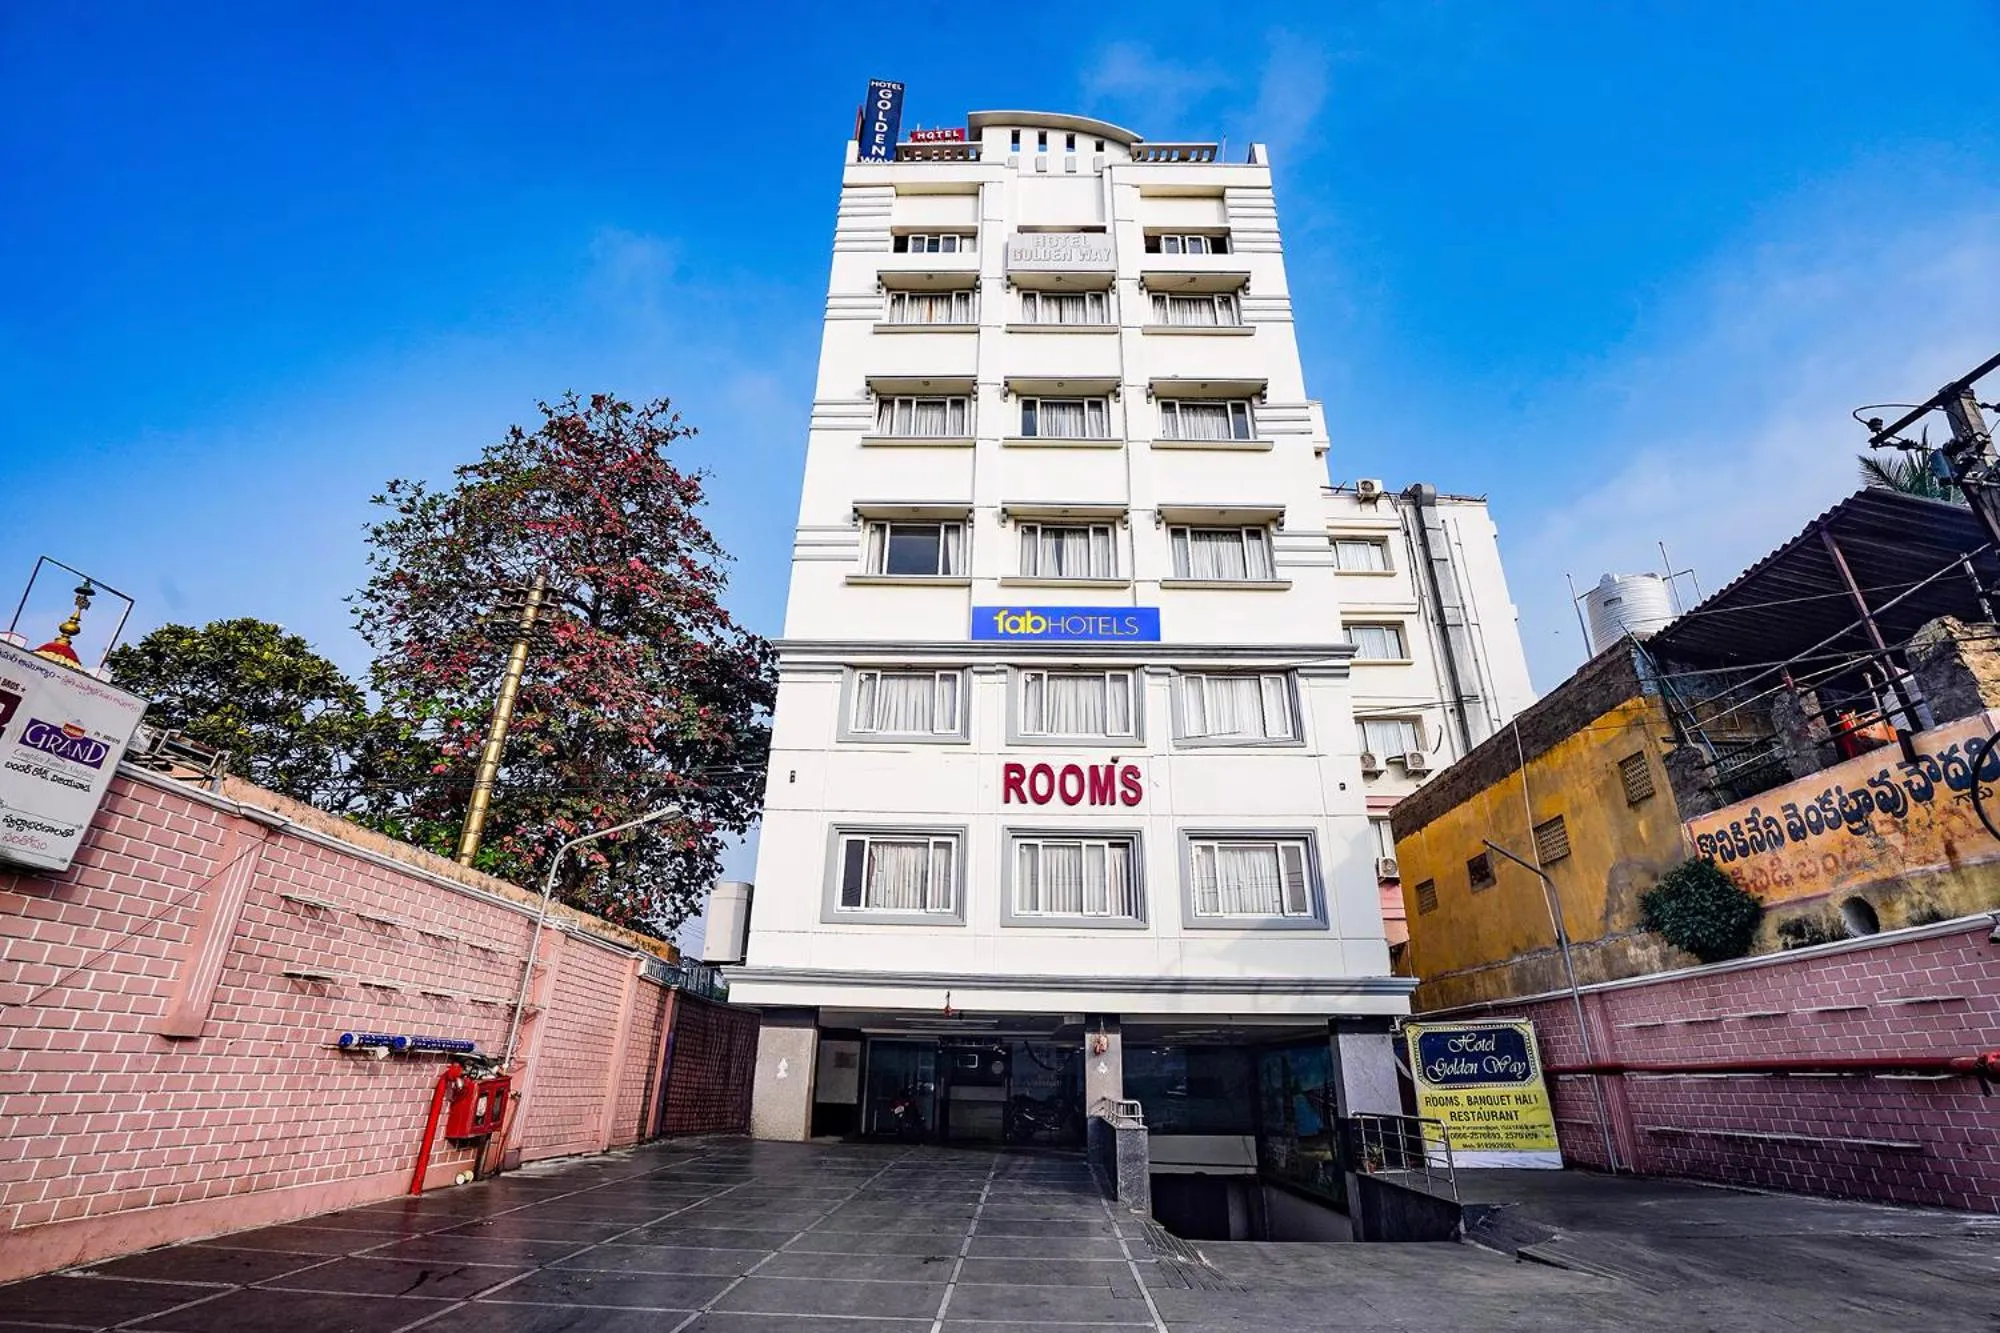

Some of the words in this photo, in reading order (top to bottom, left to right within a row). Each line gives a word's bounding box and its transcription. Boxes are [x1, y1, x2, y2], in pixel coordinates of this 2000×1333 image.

[870, 80, 902, 90] HOTEL
[871, 89, 893, 156] GOLDEN
[917, 130, 960, 140] HOTEL
[860, 155, 894, 164] WAY
[1033, 235, 1091, 248] HOTEL
[1012, 247, 1074, 261] GOLDEN
[1080, 247, 1112, 261] WAY
[993, 609, 1139, 635] fabHOTELS
[25, 723, 106, 764] GRAND
[1004, 763, 1143, 806] ROOMS
[1448, 1032, 1496, 1053] Hotel
[1426, 1057, 1478, 1082] Golden
[1483, 1054, 1527, 1080] Way
[1466, 1094, 1511, 1106] BANQUET
[1449, 1110, 1520, 1122] RESTAURANT
